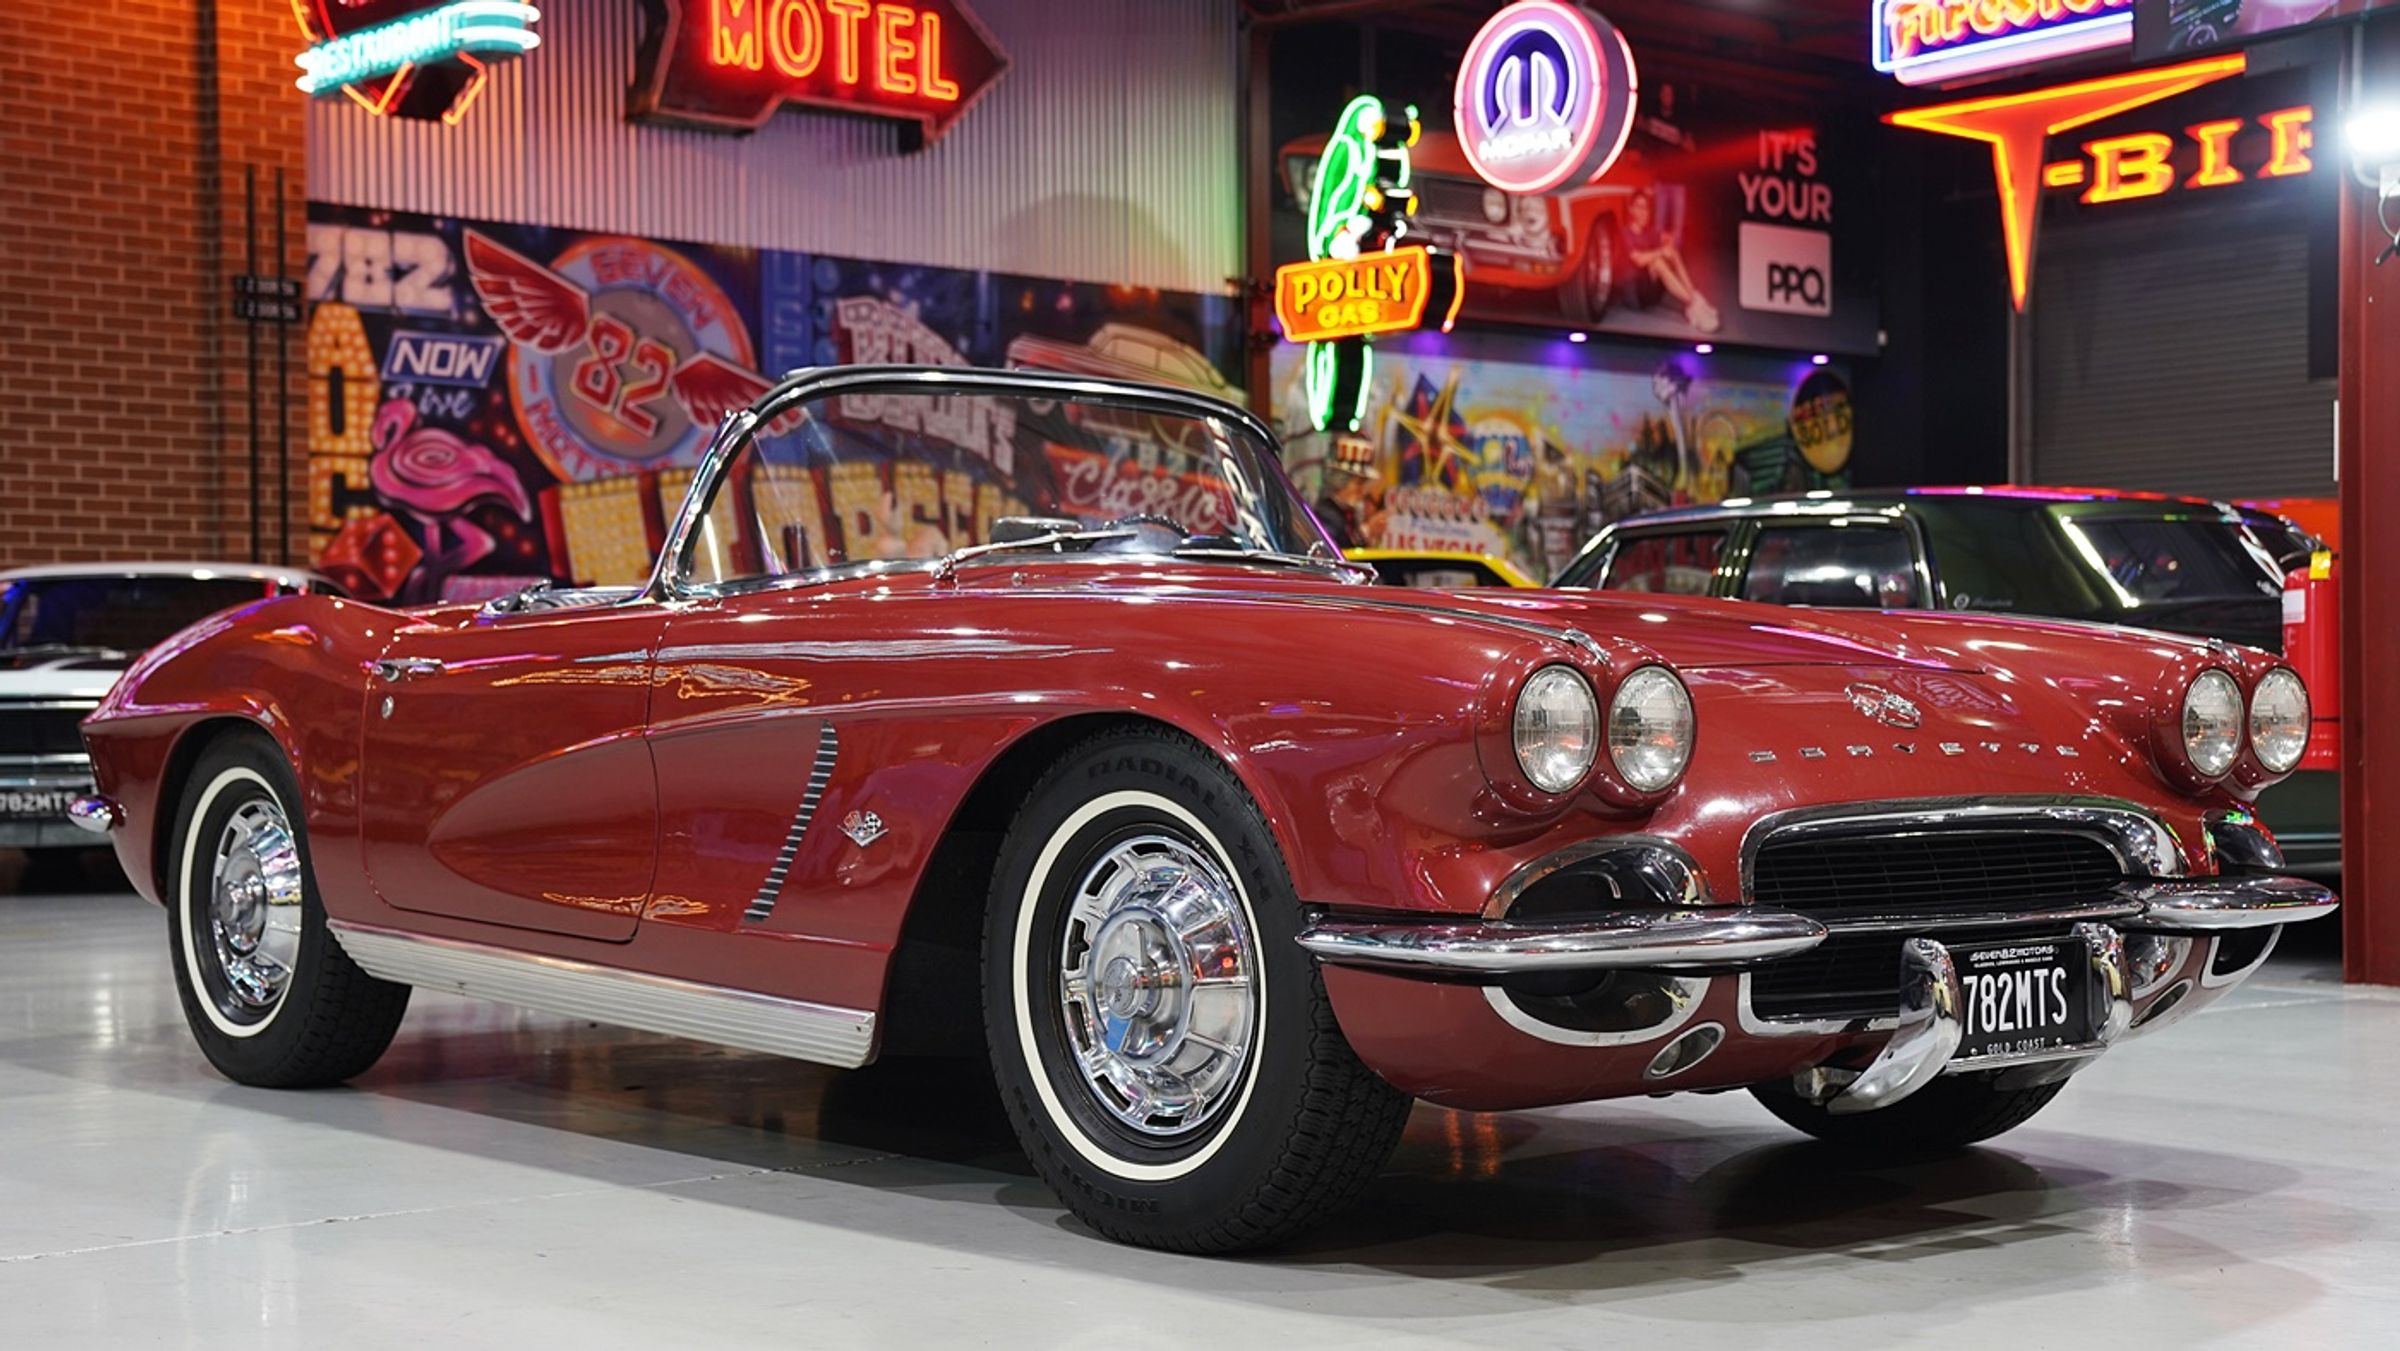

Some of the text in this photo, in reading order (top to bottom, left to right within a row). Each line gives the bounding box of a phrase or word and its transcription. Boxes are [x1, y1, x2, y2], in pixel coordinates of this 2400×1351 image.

[711, 0, 959, 101] MOTEL
[1479, 126, 1573, 161] MOPAR
[1759, 129, 1818, 177] IT'S
[1738, 170, 1832, 223] YOUR
[307, 225, 452, 312] 782
[1292, 262, 1410, 314] POLLY
[1768, 262, 1826, 308] PPQ
[1317, 300, 1380, 329] GAS
[391, 338, 492, 380] NOW
[570, 312, 678, 438] 82
[1086, 755, 1223, 819] RADIAL
[1962, 966, 2068, 1036] 782MTS
[2016, 1037, 2046, 1051] COAST
